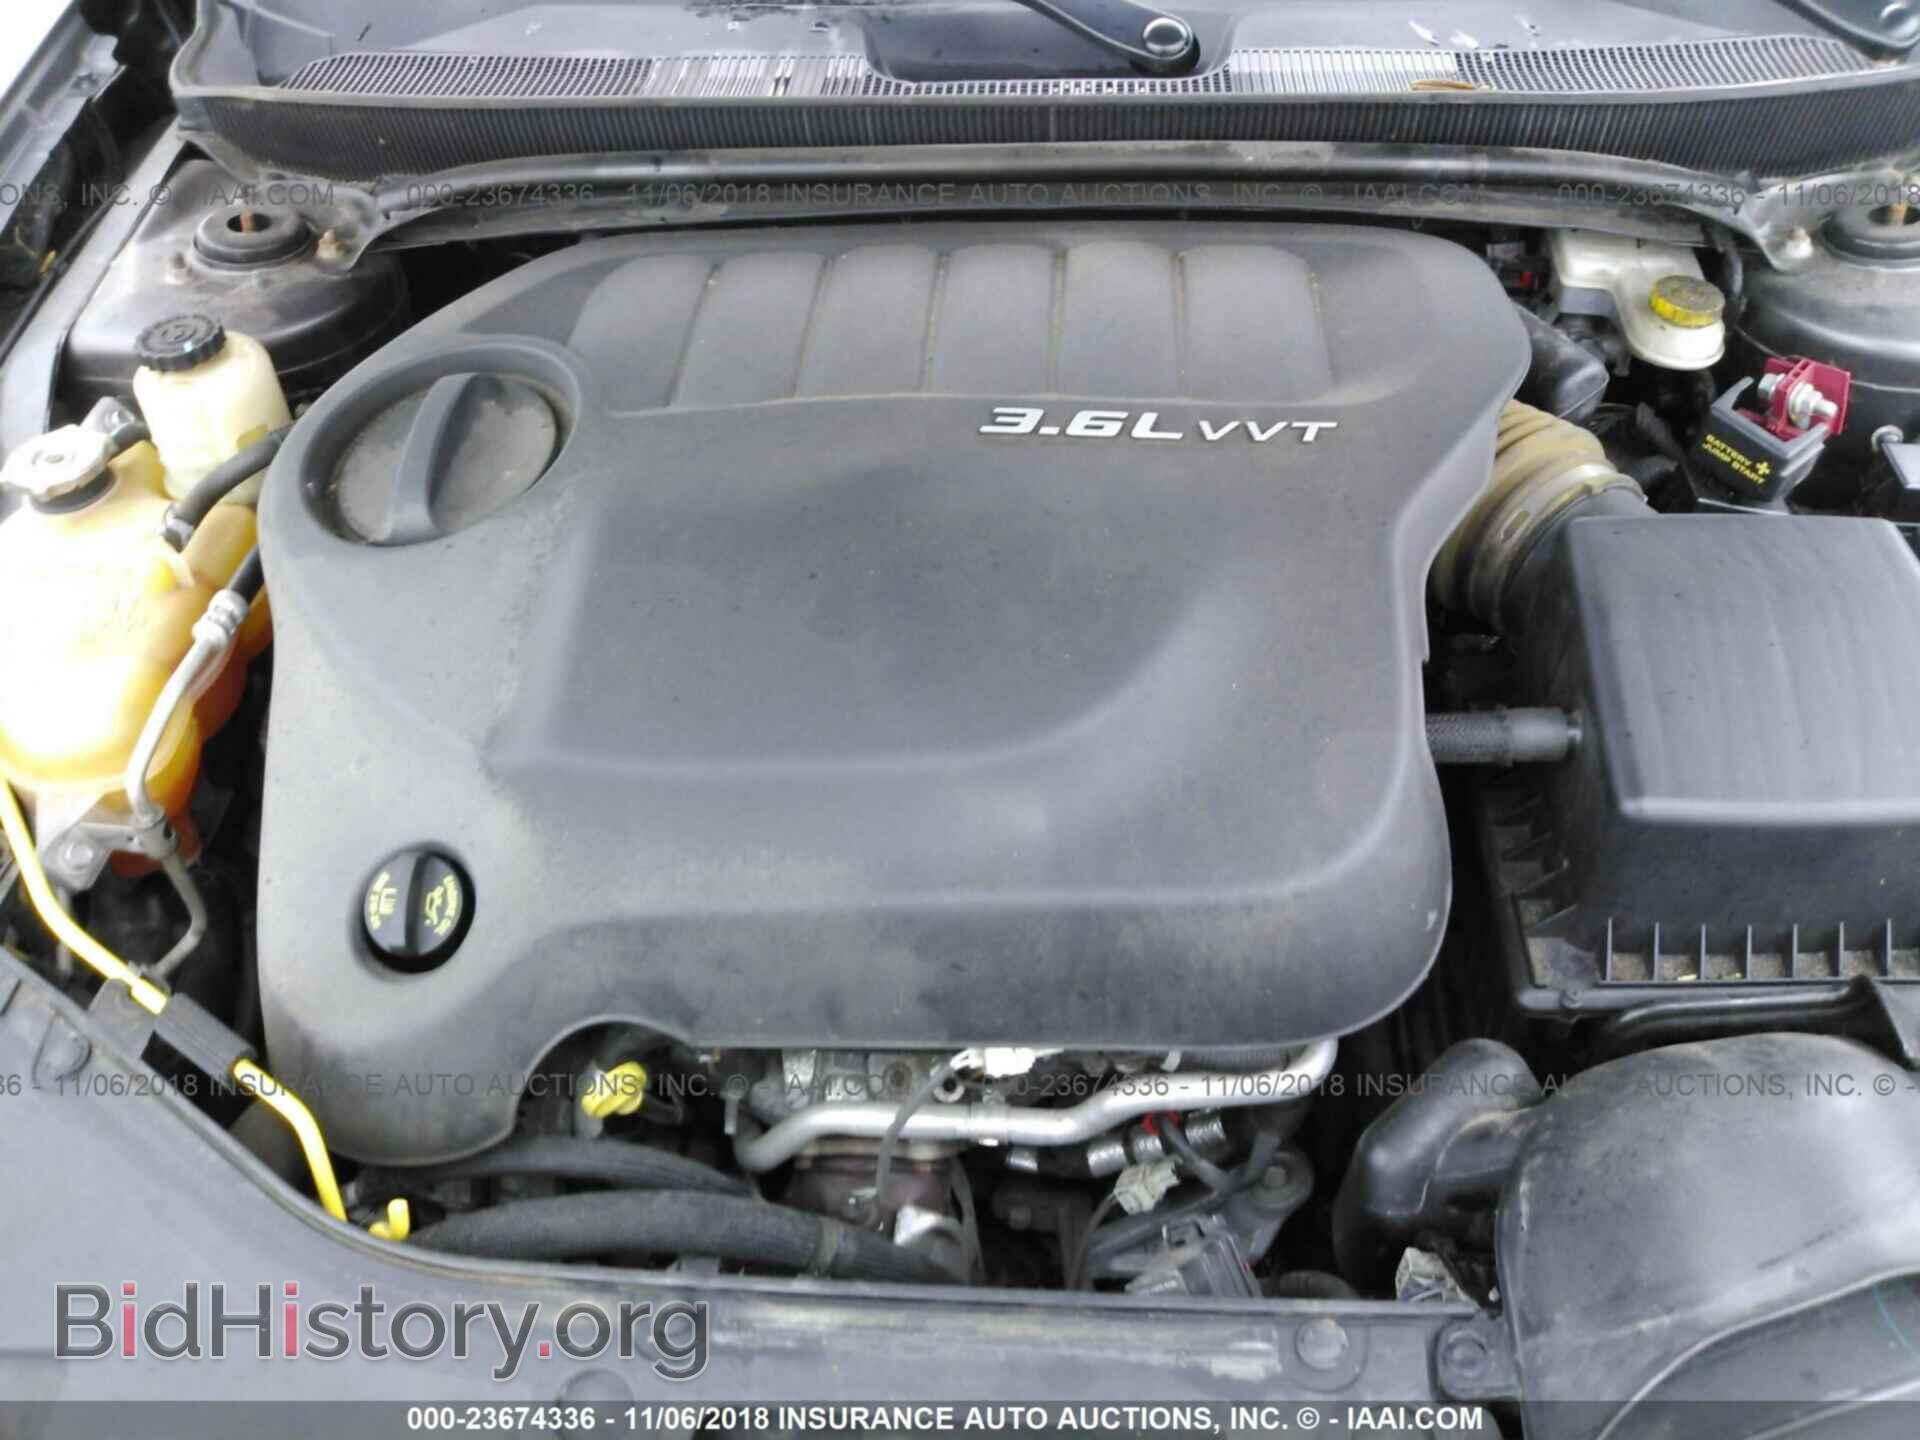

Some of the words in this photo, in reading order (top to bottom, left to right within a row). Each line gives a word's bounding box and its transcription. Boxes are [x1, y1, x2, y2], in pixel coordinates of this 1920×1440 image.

[979, 406, 1184, 441] 3.6L
[1199, 420, 1338, 442] VVT
[1705, 433, 1753, 467] BATTERY
